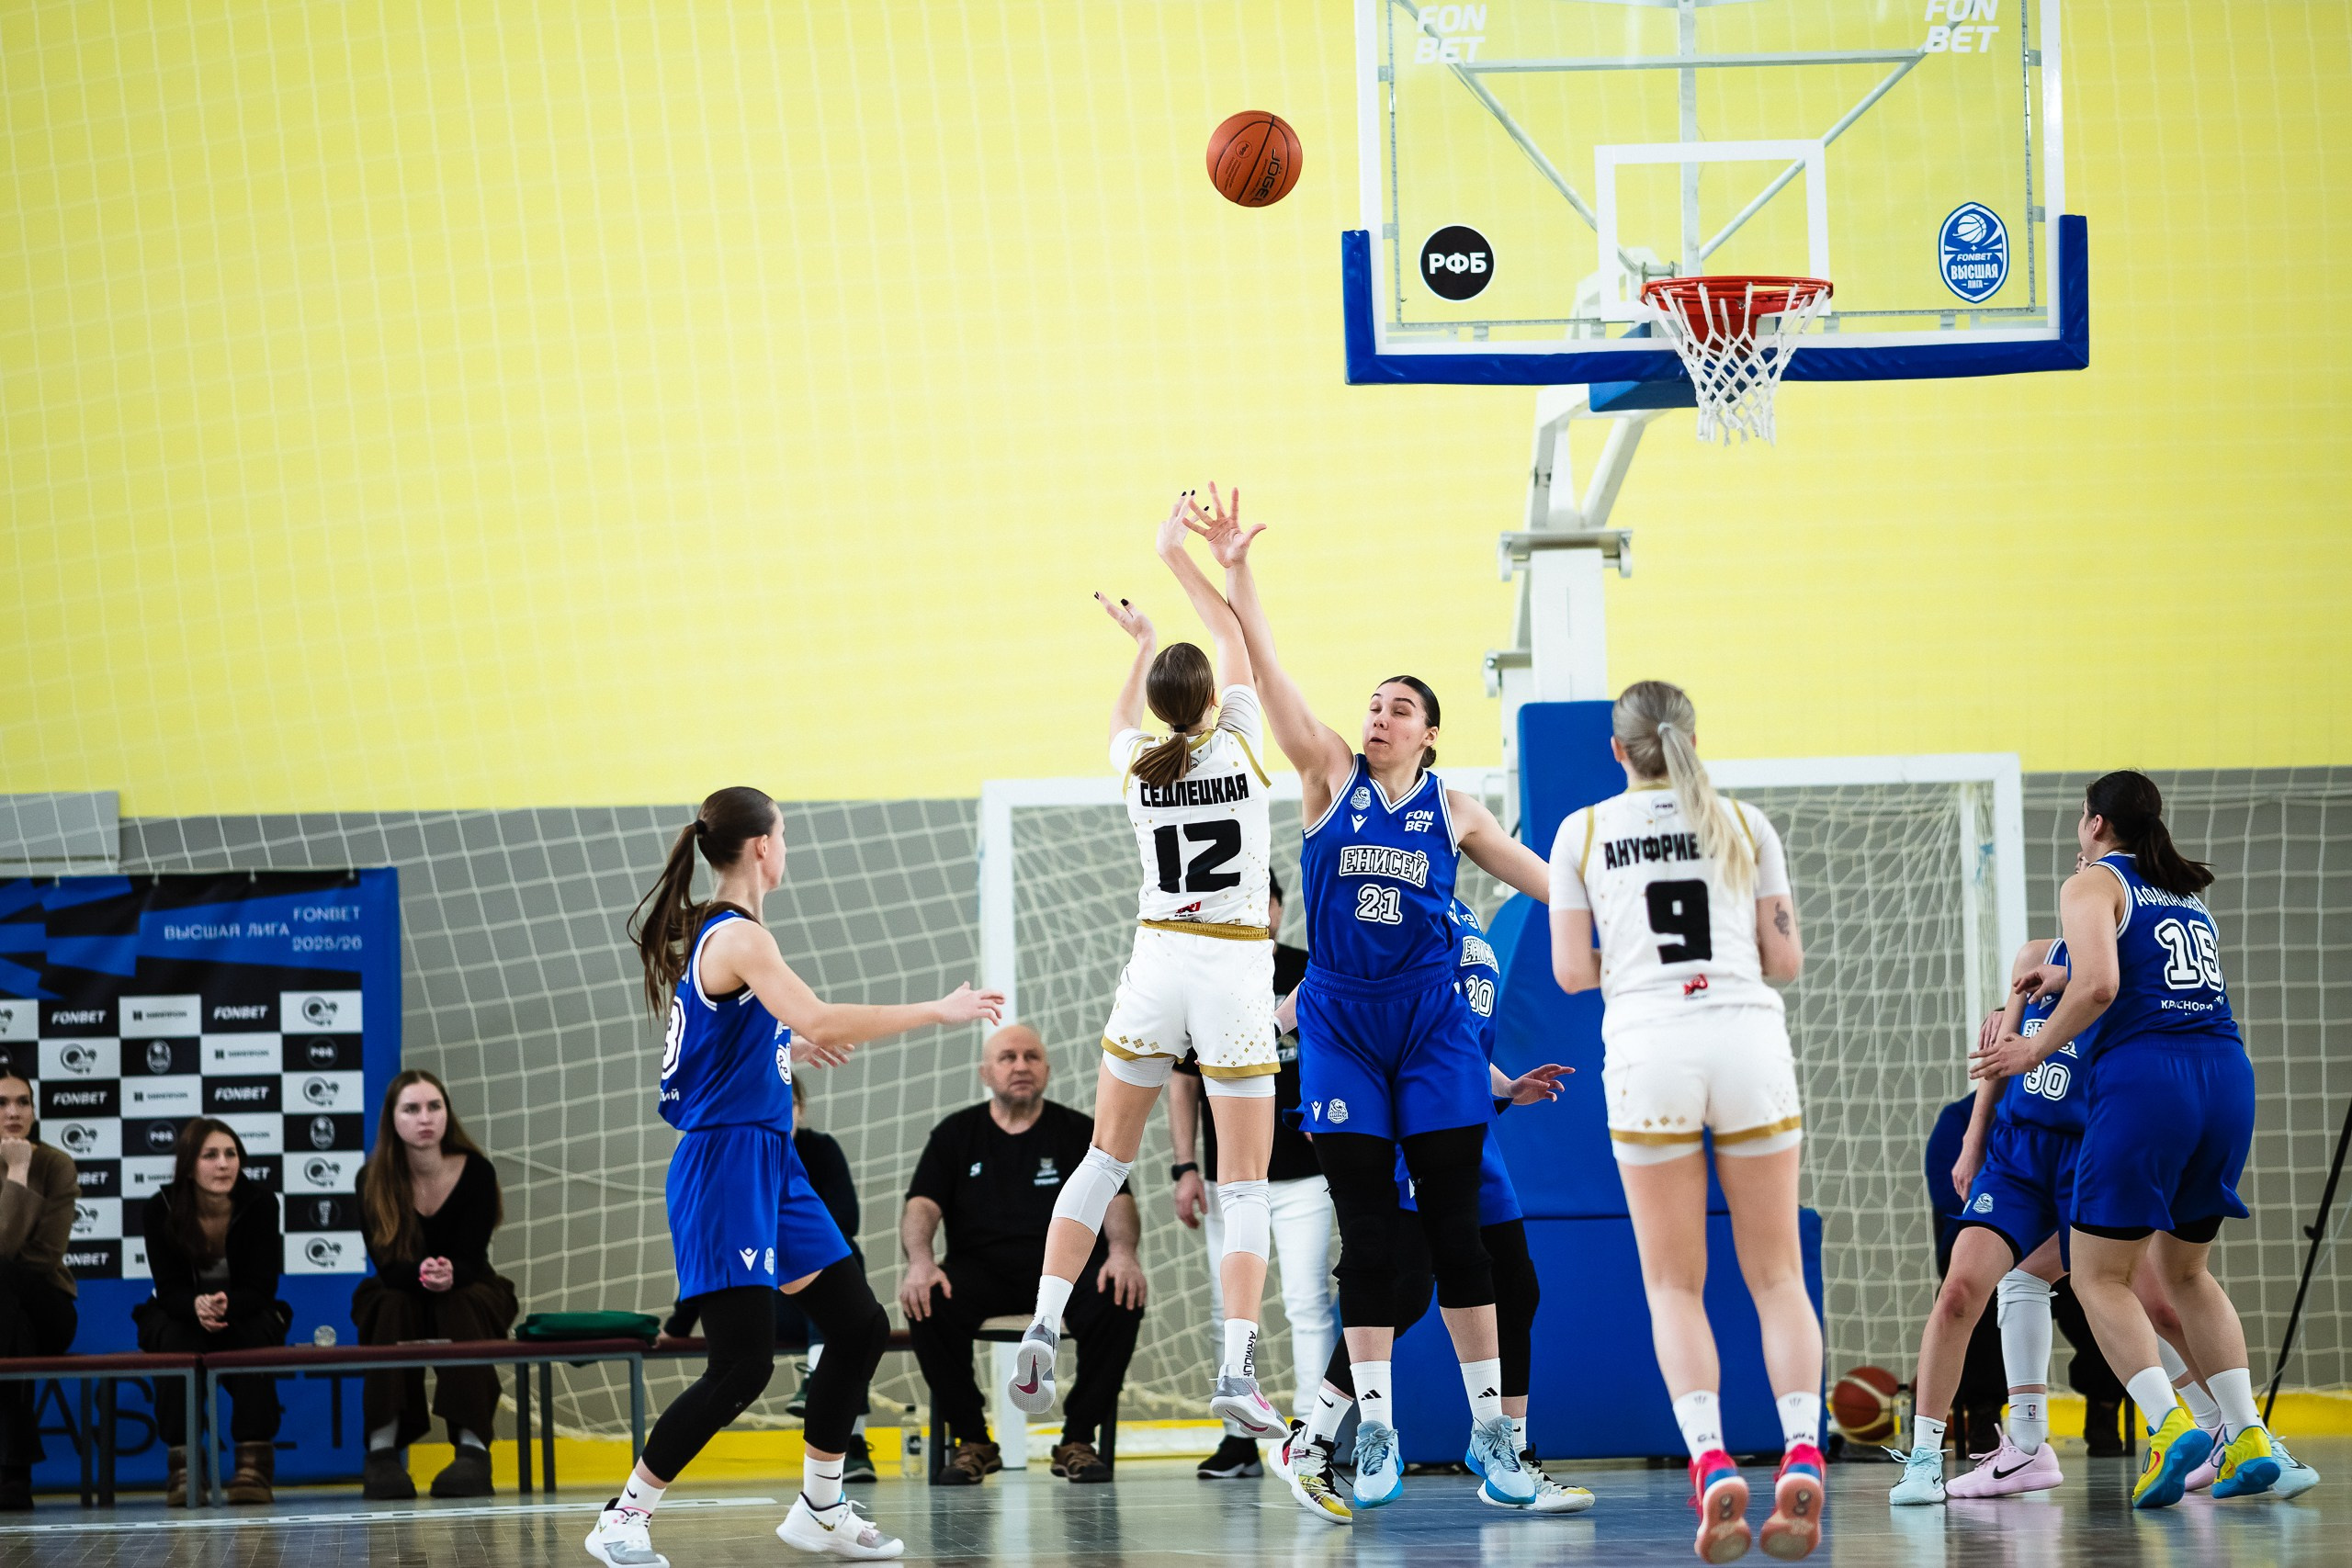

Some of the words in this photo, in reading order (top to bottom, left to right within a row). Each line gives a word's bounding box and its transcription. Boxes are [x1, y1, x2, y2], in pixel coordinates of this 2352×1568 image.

[1417, 4, 1487, 33] FON
[1925, 0, 1998, 22] FON
[1925, 26, 1999, 53] BET
[1414, 36, 1486, 64] BET
[1429, 252, 1487, 275] РФБ
[1956, 253, 1993, 262] FONBET
[1951, 263, 1998, 280] ВЫСШАЯ
[1967, 279, 1984, 289] ЛИГА
[1140, 773, 1250, 807] СЕДЛЕЦКАЯ
[1405, 809, 1435, 821] FON
[1404, 820, 1433, 833] BET
[1153, 819, 1241, 894] 12
[1604, 832, 1714, 870] АНУФРИЕ
[1339, 845, 1430, 888] ЕНИСЕЙ
[293, 906, 360, 922] FONBET
[1355, 884, 1403, 925] 21
[164, 922, 241, 941] ВЫСШАЯ
[246, 921, 290, 939] ЛИГА
[1645, 879, 1713, 964] 9
[291, 934, 362, 952] 2025/26
[1464, 975, 1494, 1017] 20
[51, 1010, 107, 1025] FONBET
[213, 1005, 268, 1021] FONBET
[2023, 1061, 2071, 1100] 30
[52, 1090, 107, 1106] FONBET
[214, 1086, 269, 1101] FONBET
[243, 1167, 271, 1181] BET
[62, 1252, 109, 1267] ONBET
